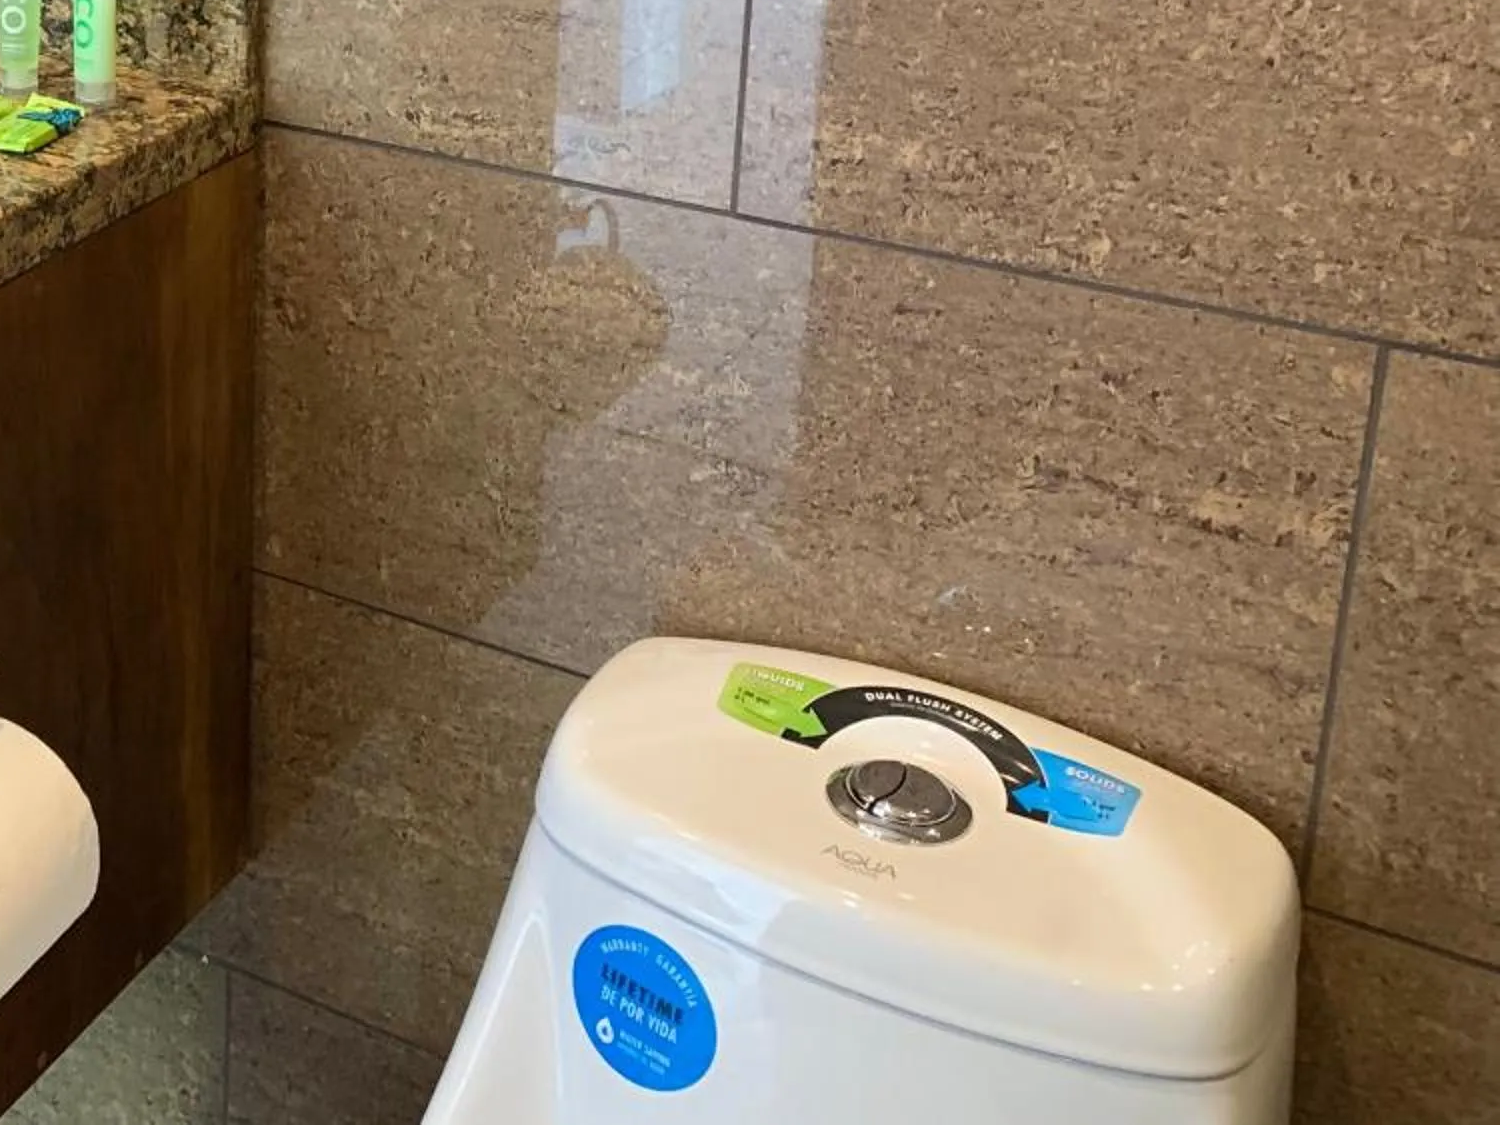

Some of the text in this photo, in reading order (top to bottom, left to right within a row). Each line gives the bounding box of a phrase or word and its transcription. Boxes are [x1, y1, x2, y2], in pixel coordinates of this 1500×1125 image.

[863, 691, 903, 703] DUAL
[907, 693, 951, 713] FLUSH
[954, 709, 1004, 741] SYSTEM
[819, 843, 897, 880] AQUA
[601, 961, 685, 1026] LIFETIME
[601, 984, 677, 1045] DE POR VIDA
